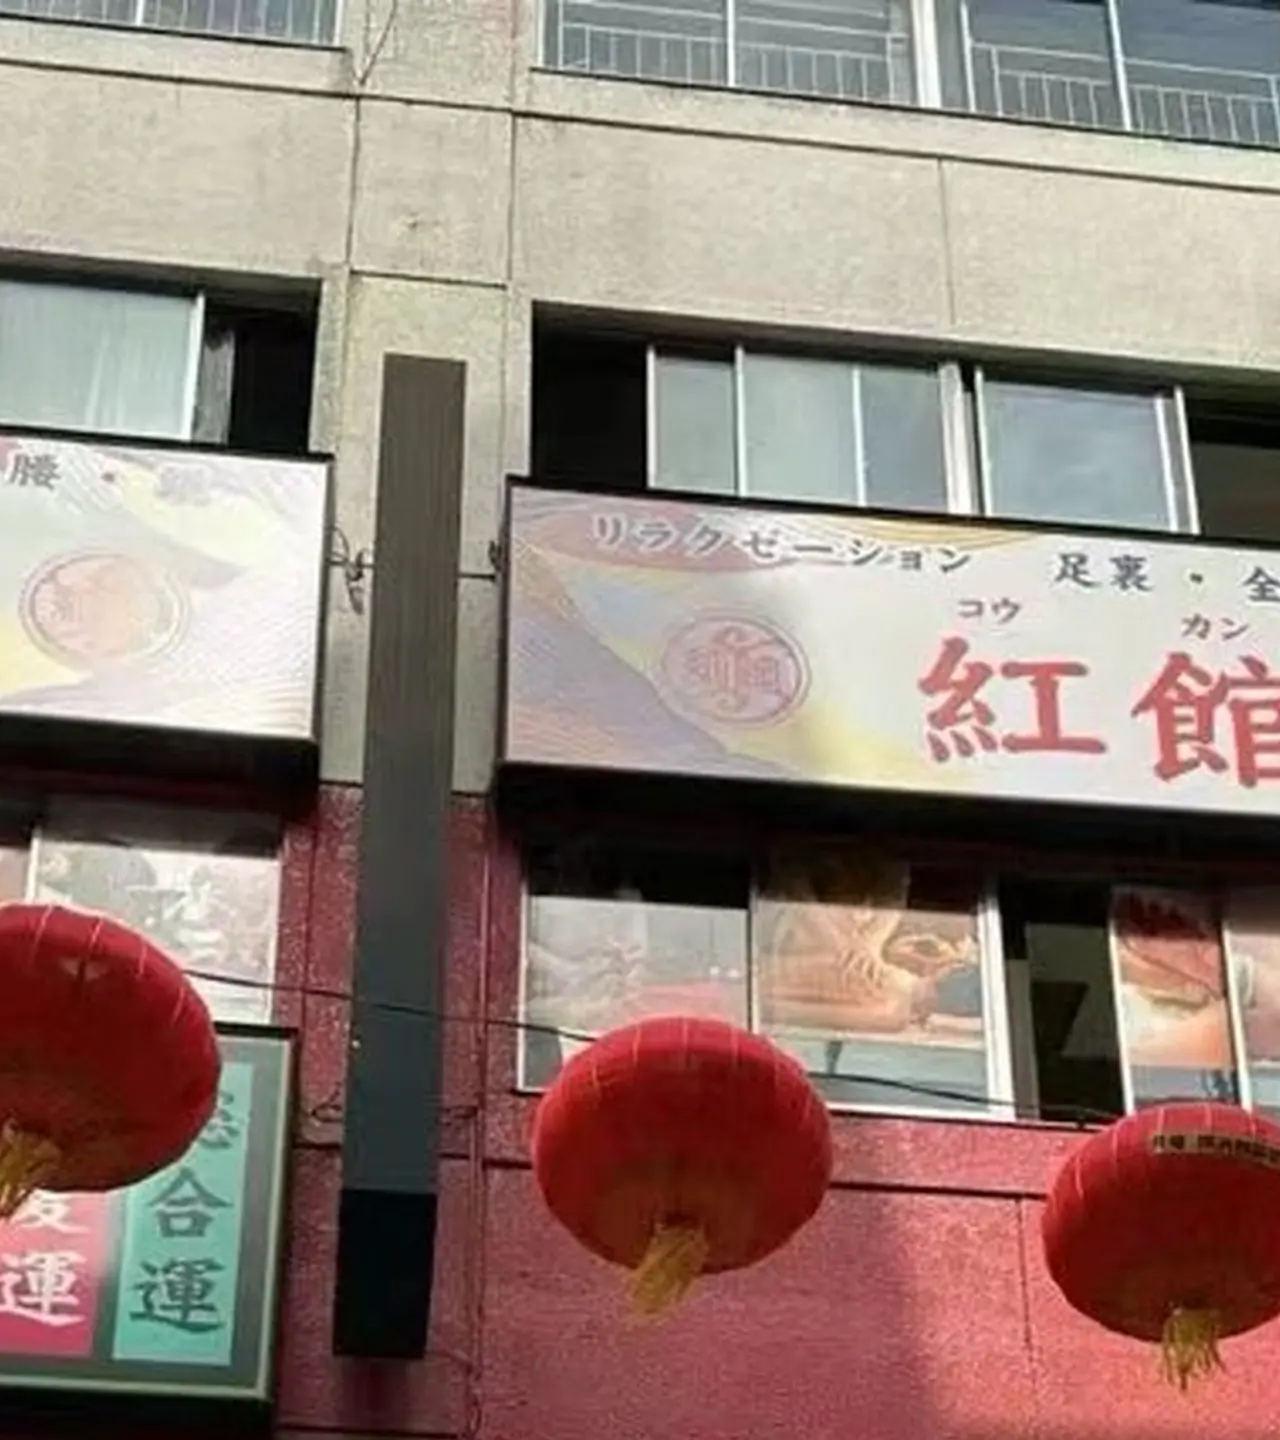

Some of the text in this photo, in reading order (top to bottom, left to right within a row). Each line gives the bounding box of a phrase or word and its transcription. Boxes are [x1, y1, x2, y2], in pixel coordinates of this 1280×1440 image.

[592, 513, 972, 575] リラクゼーション
[958, 598, 1021, 625] コウ
[1180, 612, 1248, 643] カン
